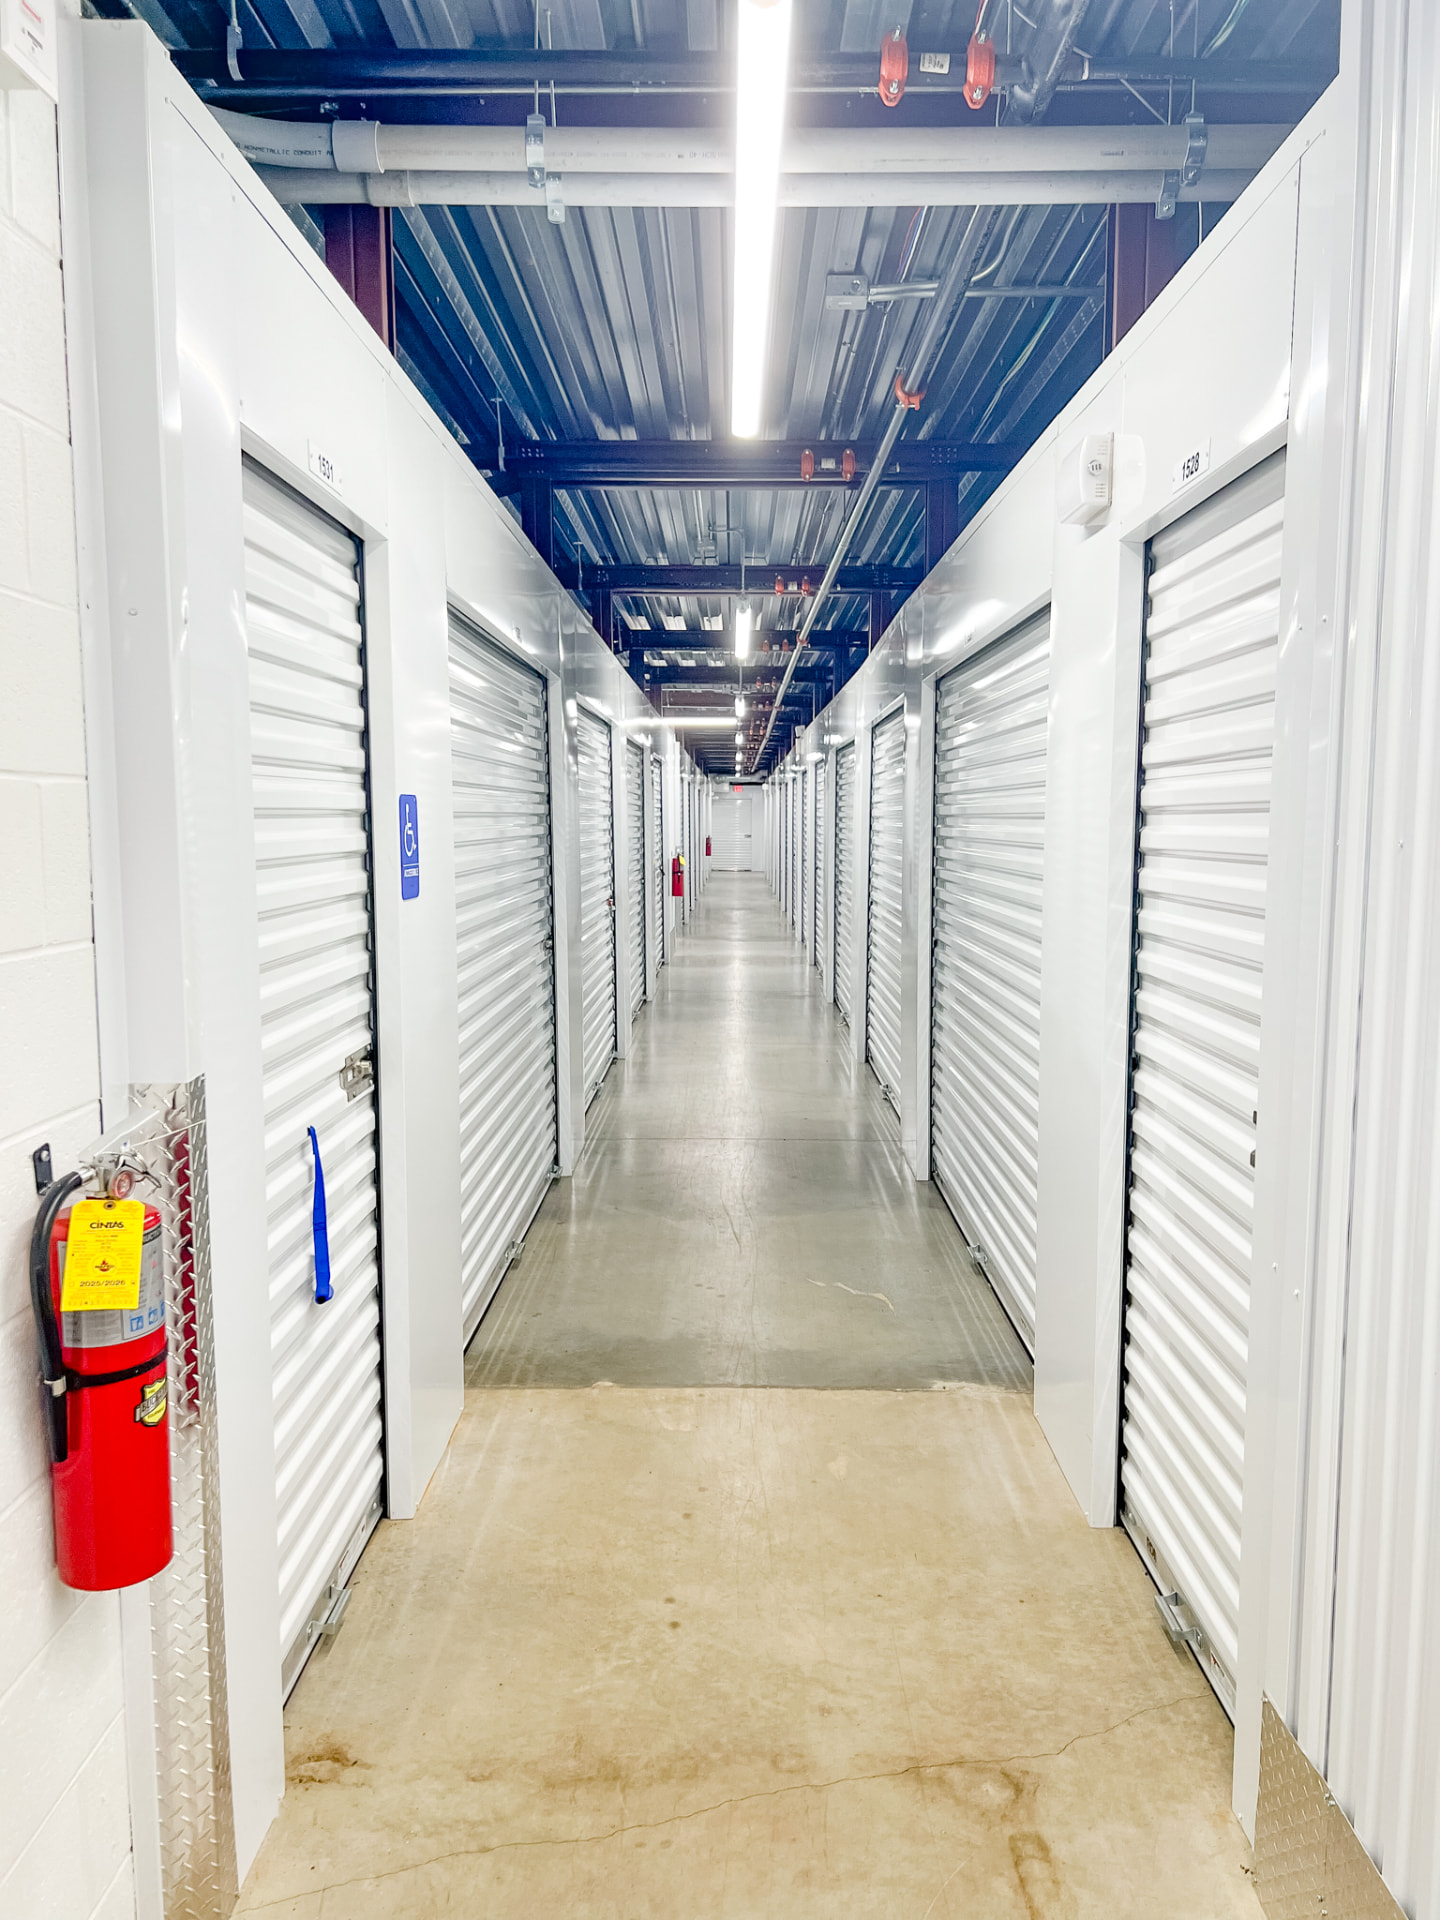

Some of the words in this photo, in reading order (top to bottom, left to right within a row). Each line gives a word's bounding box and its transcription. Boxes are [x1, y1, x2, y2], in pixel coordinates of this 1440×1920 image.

[318, 453, 334, 483] 1531
[1182, 451, 1200, 481] 1528
[79, 1279, 126, 1287] 2025/2026
